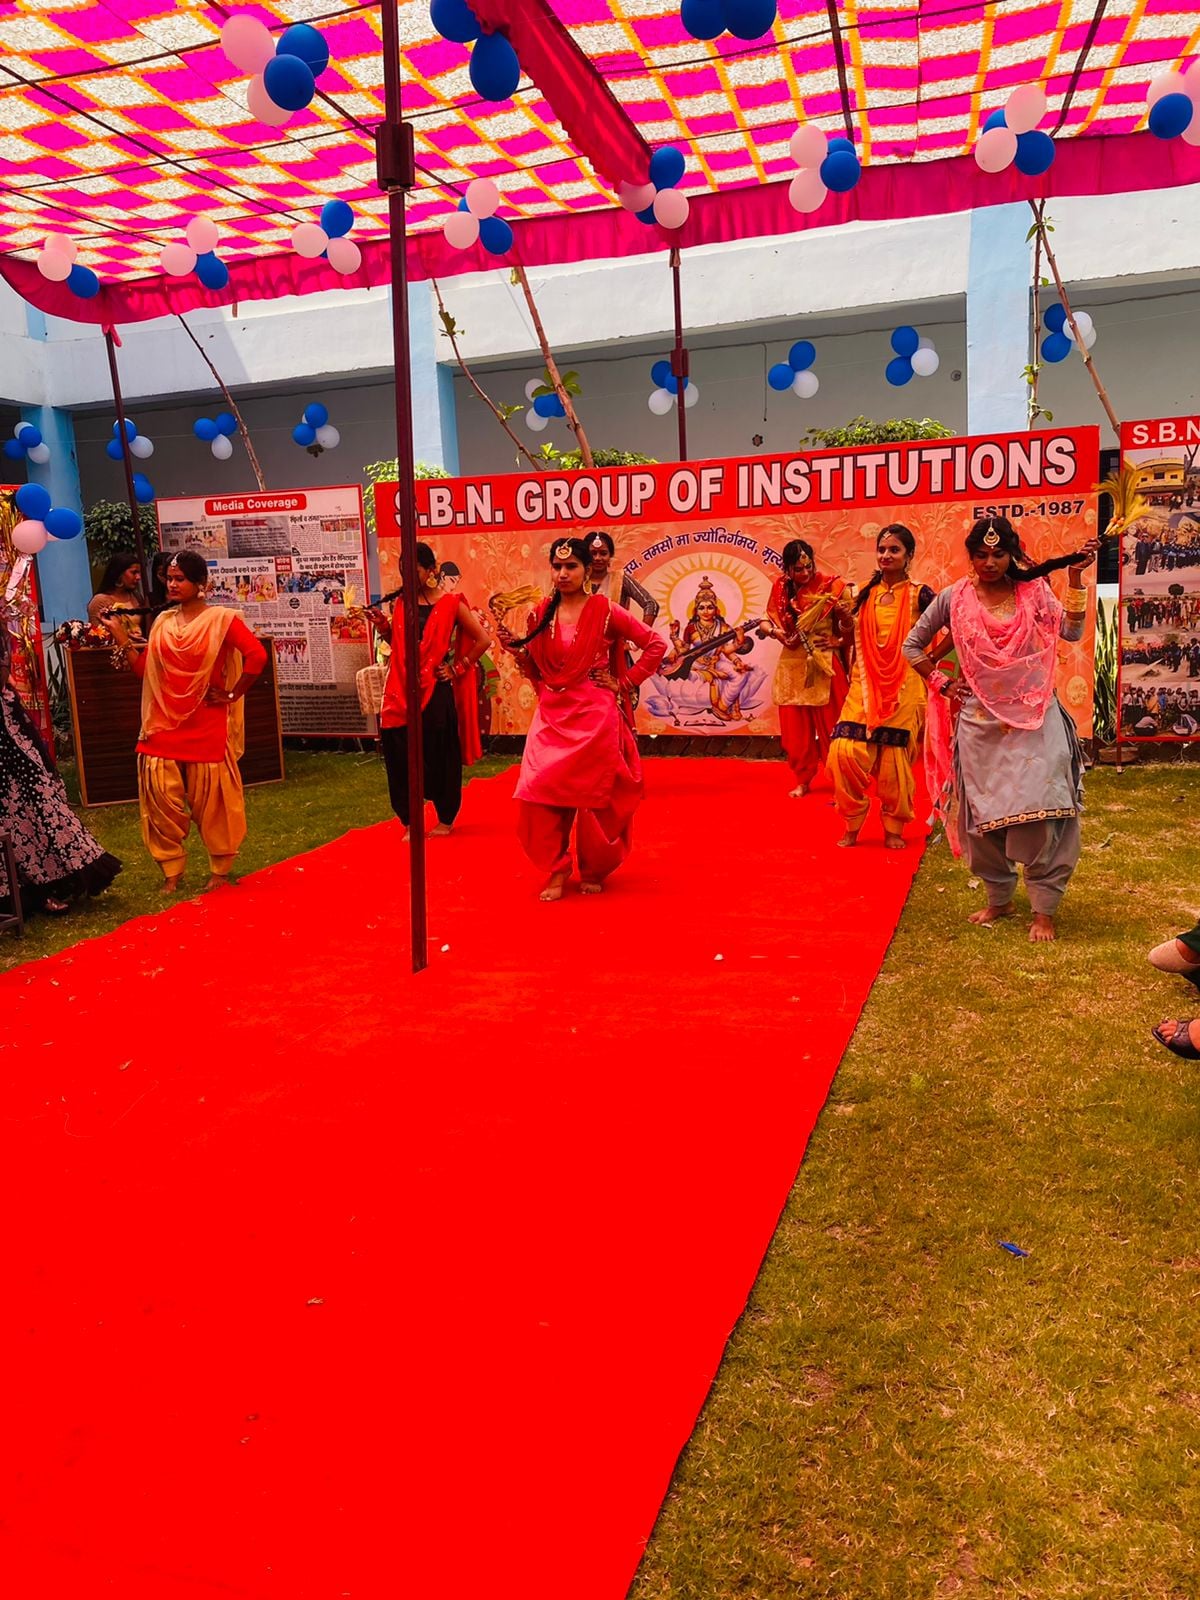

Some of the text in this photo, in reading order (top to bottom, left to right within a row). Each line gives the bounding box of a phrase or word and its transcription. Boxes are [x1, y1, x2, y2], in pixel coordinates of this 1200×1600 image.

[515, 472, 655, 523] GROUP
[668, 465, 724, 514] OF
[737, 436, 1077, 508] INSTITUTIONS
[213, 498, 298, 511] Media Coverage
[641, 535, 673, 561] तमसो
[676, 532, 690, 546] मा
